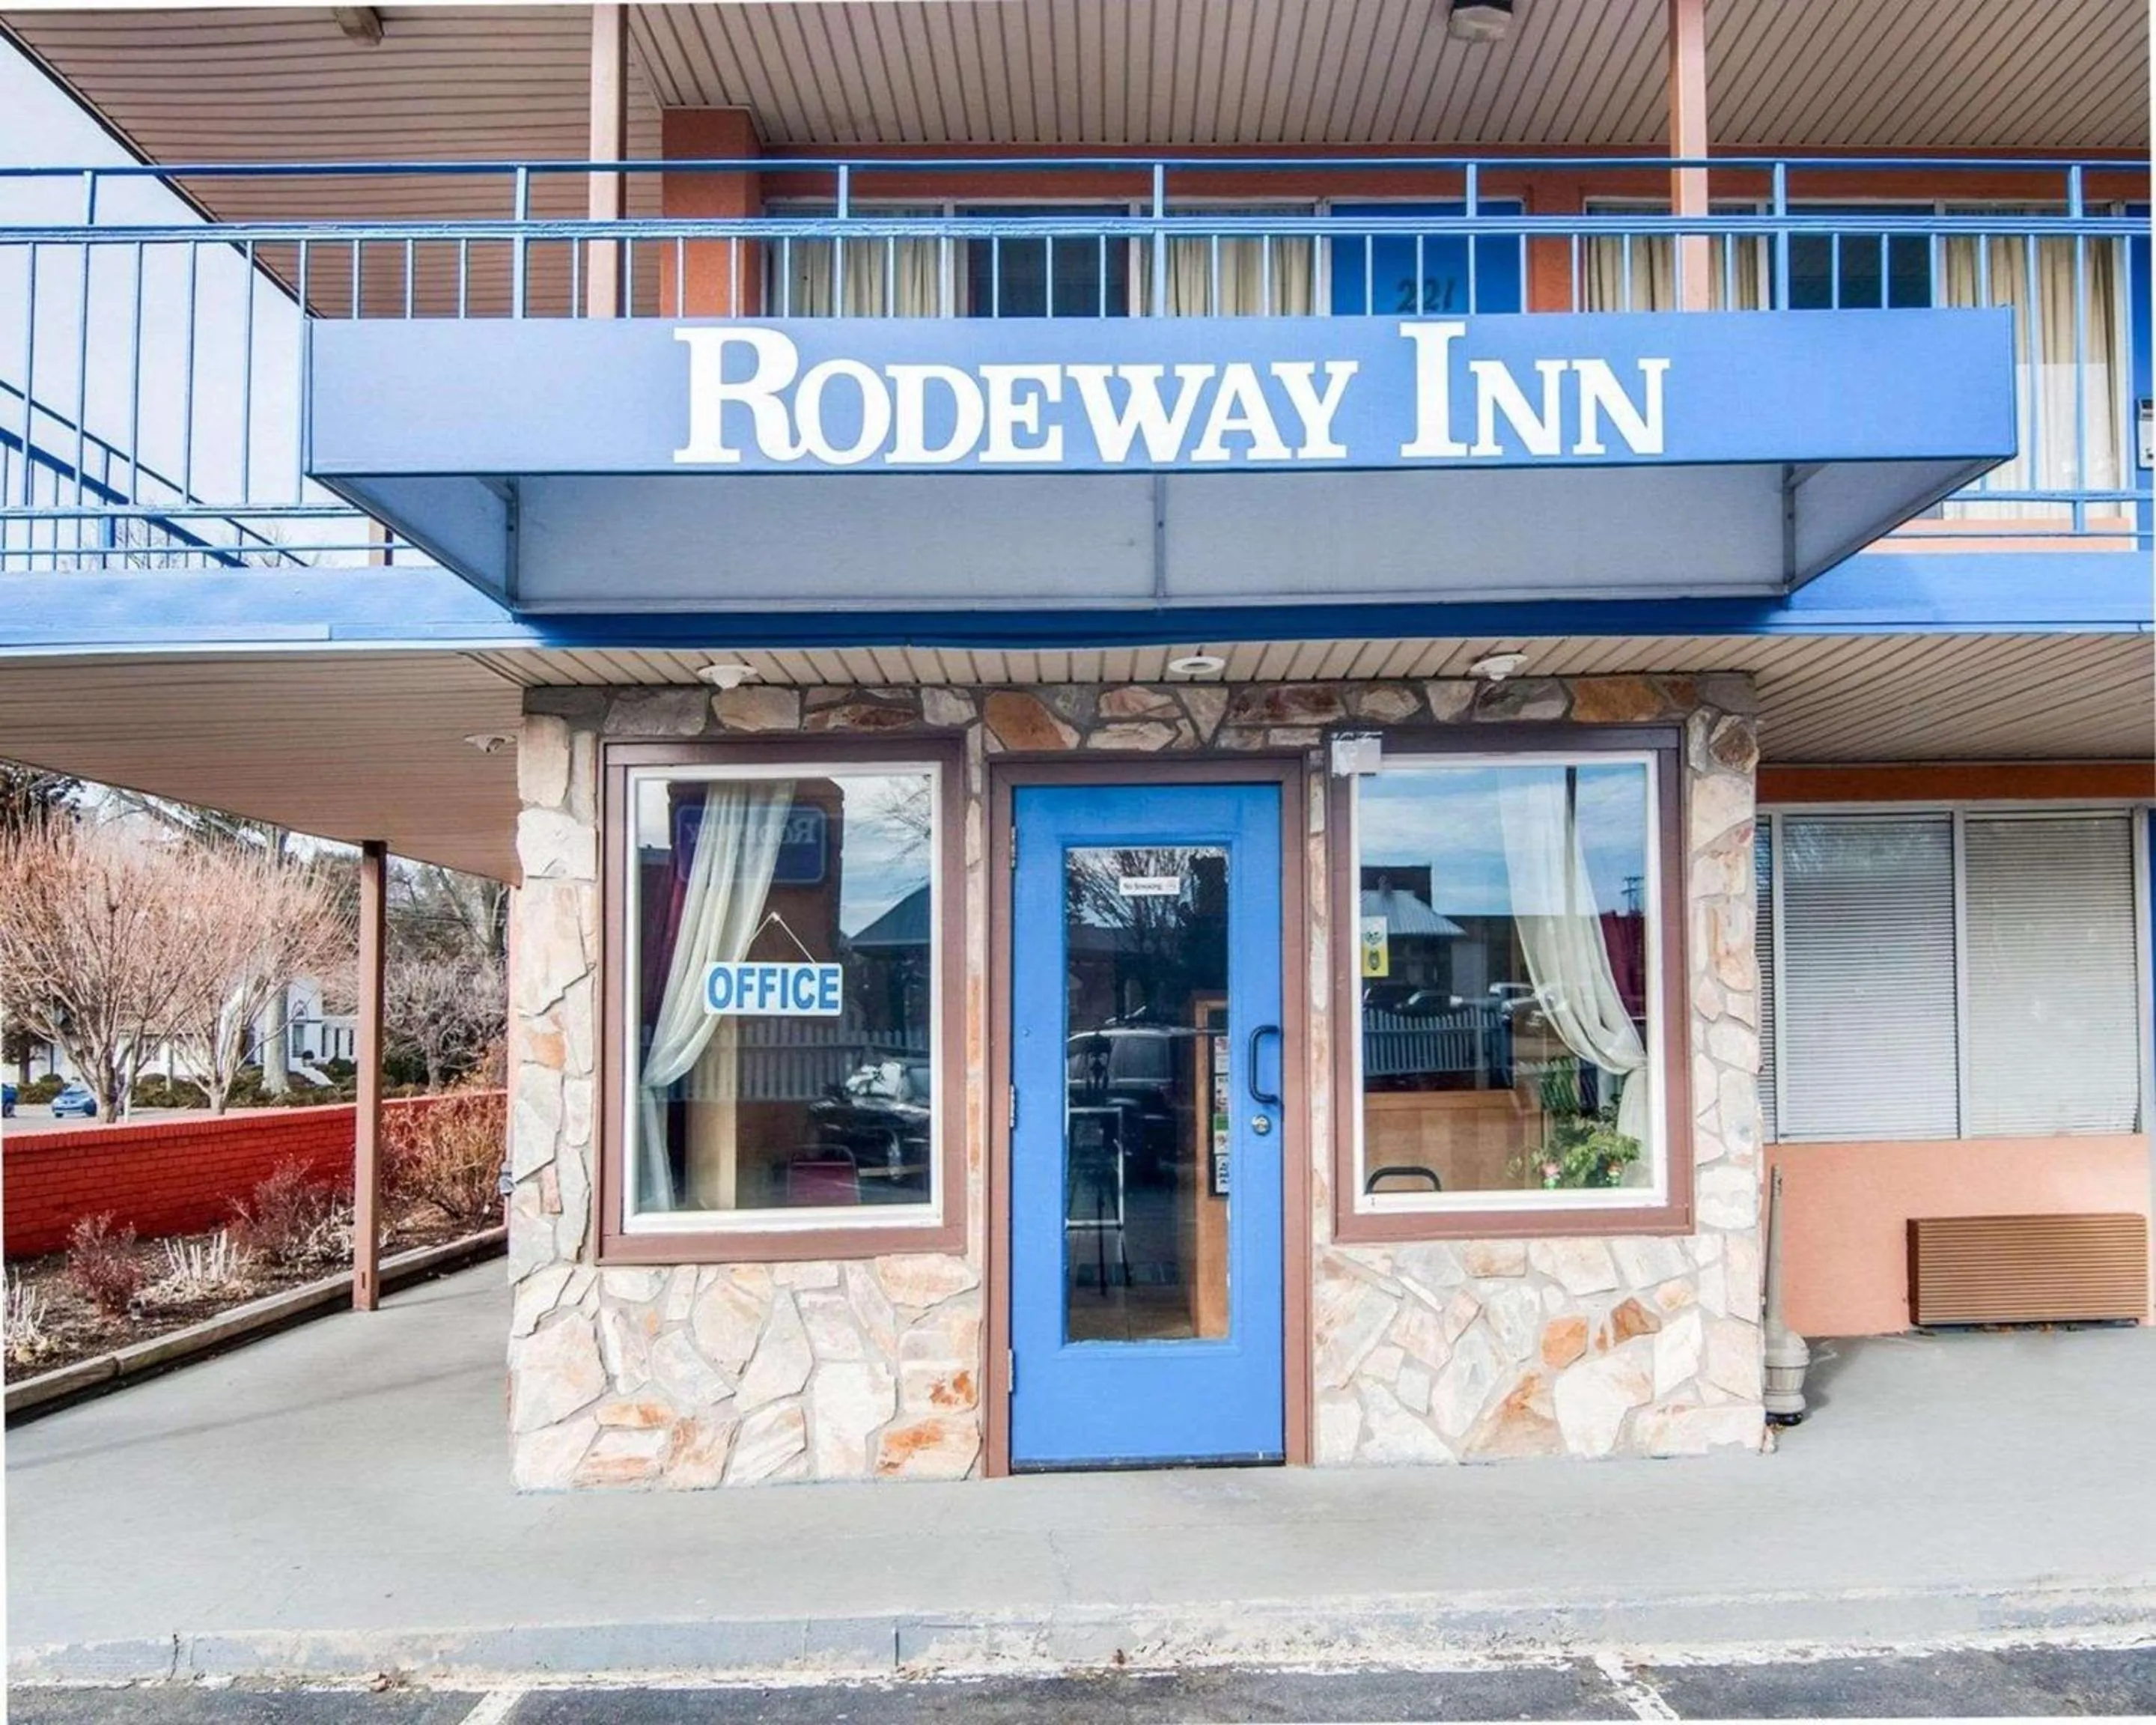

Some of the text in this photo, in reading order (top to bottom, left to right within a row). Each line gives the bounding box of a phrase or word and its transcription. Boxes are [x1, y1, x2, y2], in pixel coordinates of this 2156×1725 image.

[1397, 277, 1456, 312] 221
[674, 323, 1669, 464] RODEWAY INN
[708, 967, 839, 1010] OFFICE
